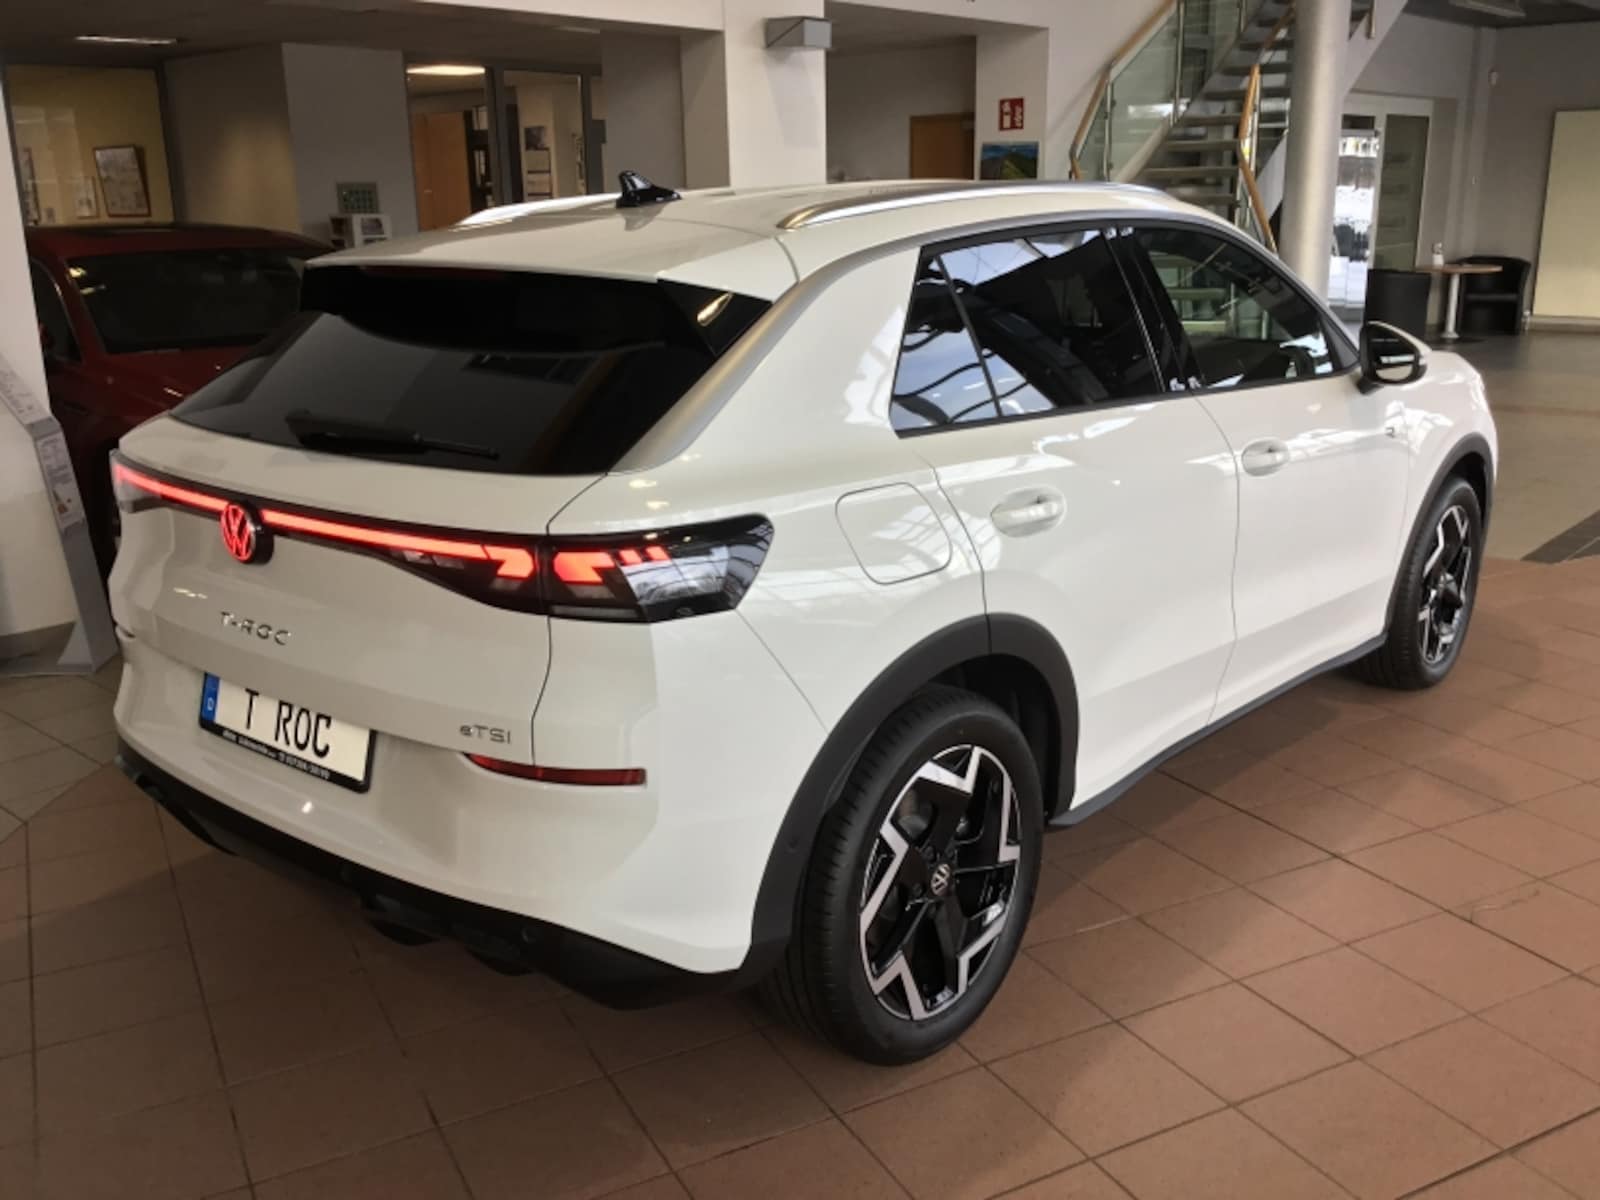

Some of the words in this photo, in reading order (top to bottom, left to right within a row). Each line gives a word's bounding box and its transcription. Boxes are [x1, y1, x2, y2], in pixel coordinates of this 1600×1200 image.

[220, 611, 292, 646] T-ROC
[245, 687, 260, 730] T
[274, 699, 332, 758] ROC
[460, 724, 511, 745] eTSI
